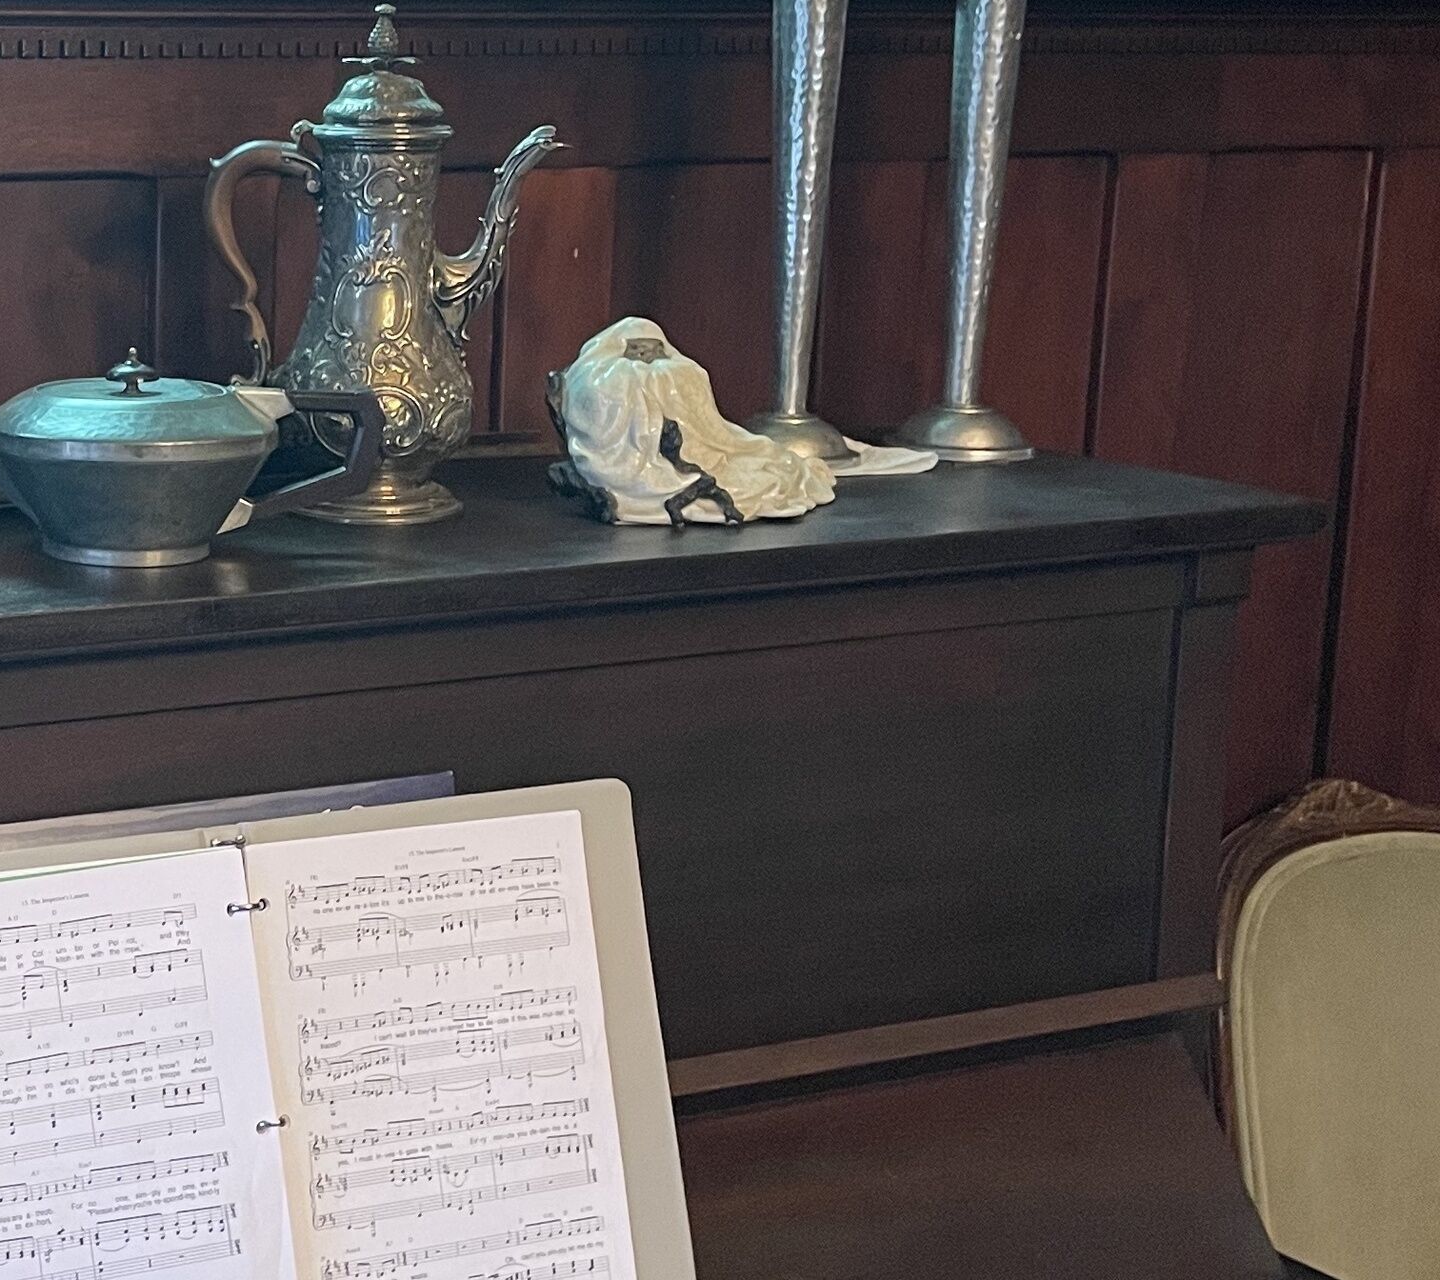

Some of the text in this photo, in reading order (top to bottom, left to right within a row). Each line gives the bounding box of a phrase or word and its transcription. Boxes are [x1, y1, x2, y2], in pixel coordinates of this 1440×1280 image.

[175, 929, 189, 938] they
[177, 937, 190, 945] And
[60, 1077, 78, 1086] who's
[121, 1068, 137, 1076] don't
[141, 1066, 153, 1074] you
[71, 1201, 83, 1210] For
